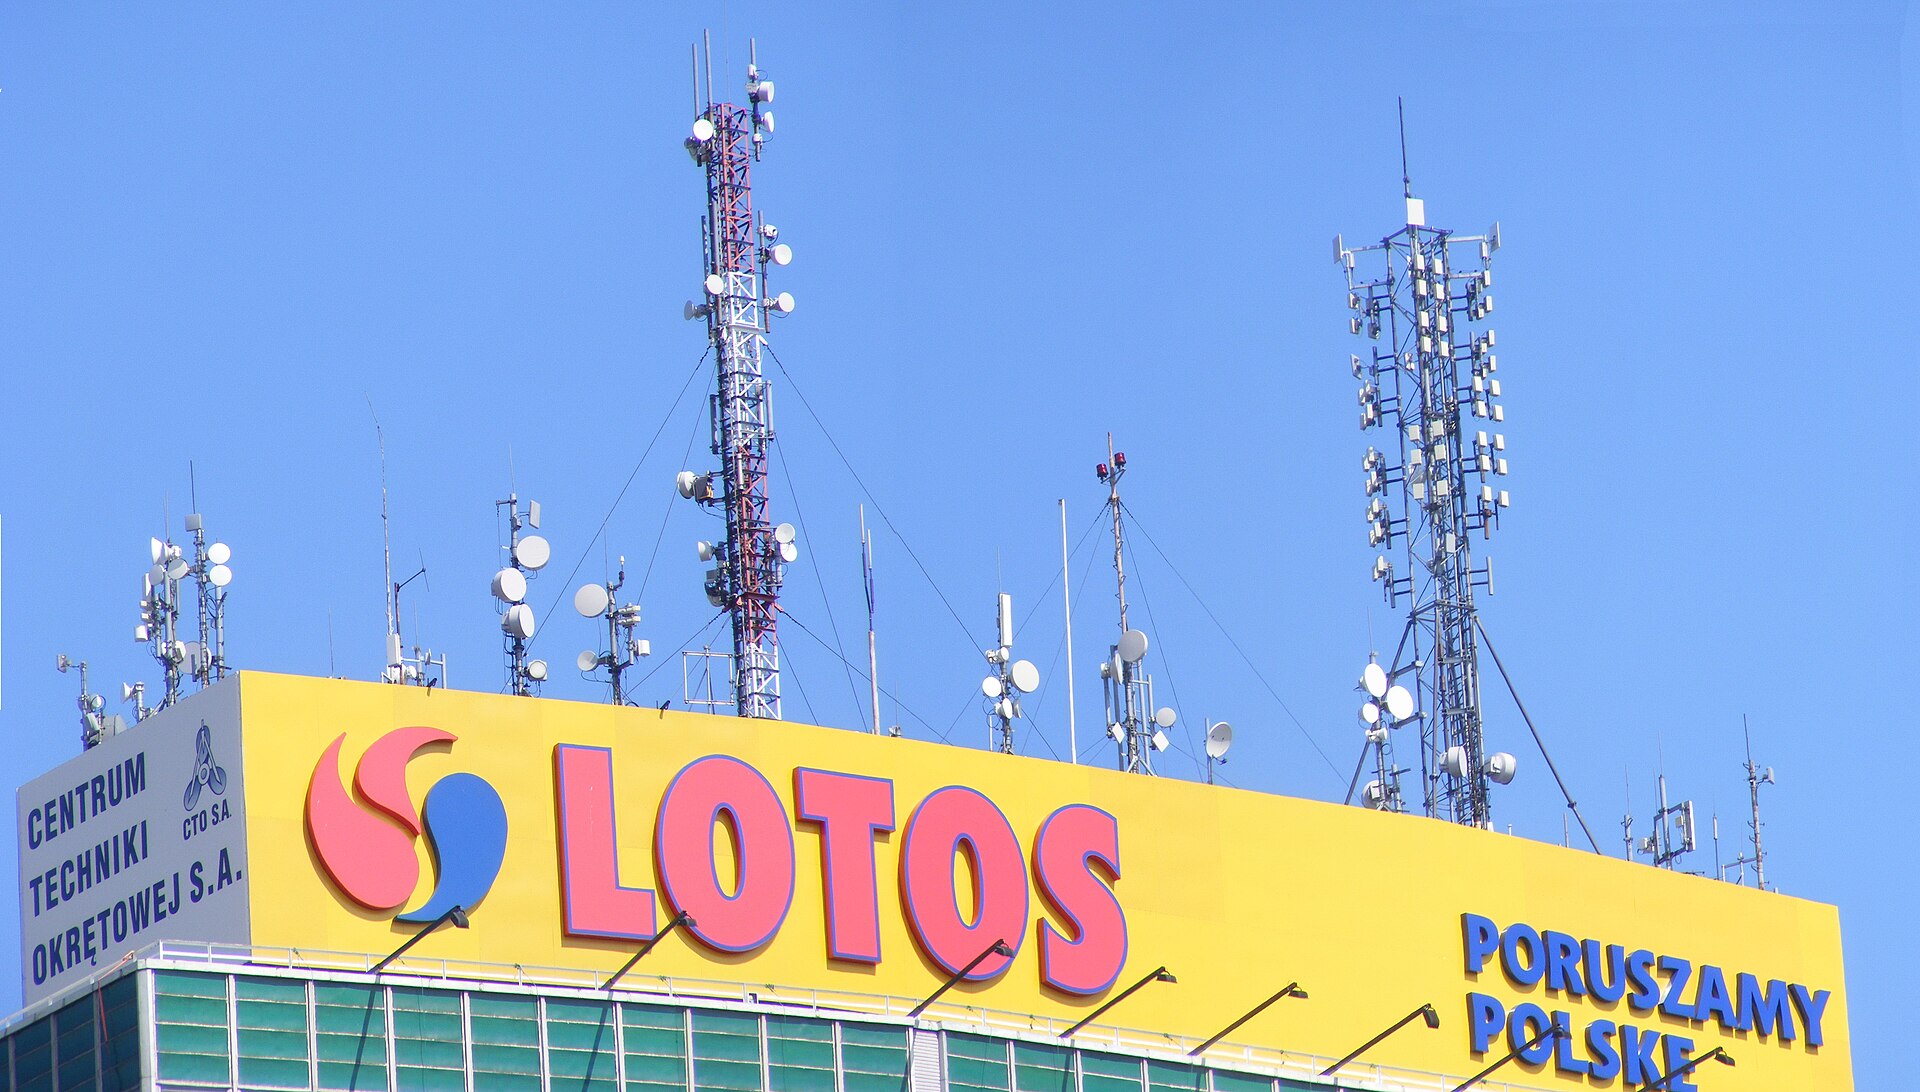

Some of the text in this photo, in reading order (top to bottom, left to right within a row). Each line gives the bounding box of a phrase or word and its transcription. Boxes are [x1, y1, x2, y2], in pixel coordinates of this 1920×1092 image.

[28, 752, 146, 850] CENTRUM
[183, 798, 232, 840] CTO S.A.
[30, 820, 148, 917] TECHNIKI
[33, 847, 242, 985] OKRĘTOWEJ S.A.
[553, 743, 1128, 996] LOTOS
[1460, 912, 1831, 1046] PORUSZAMY
